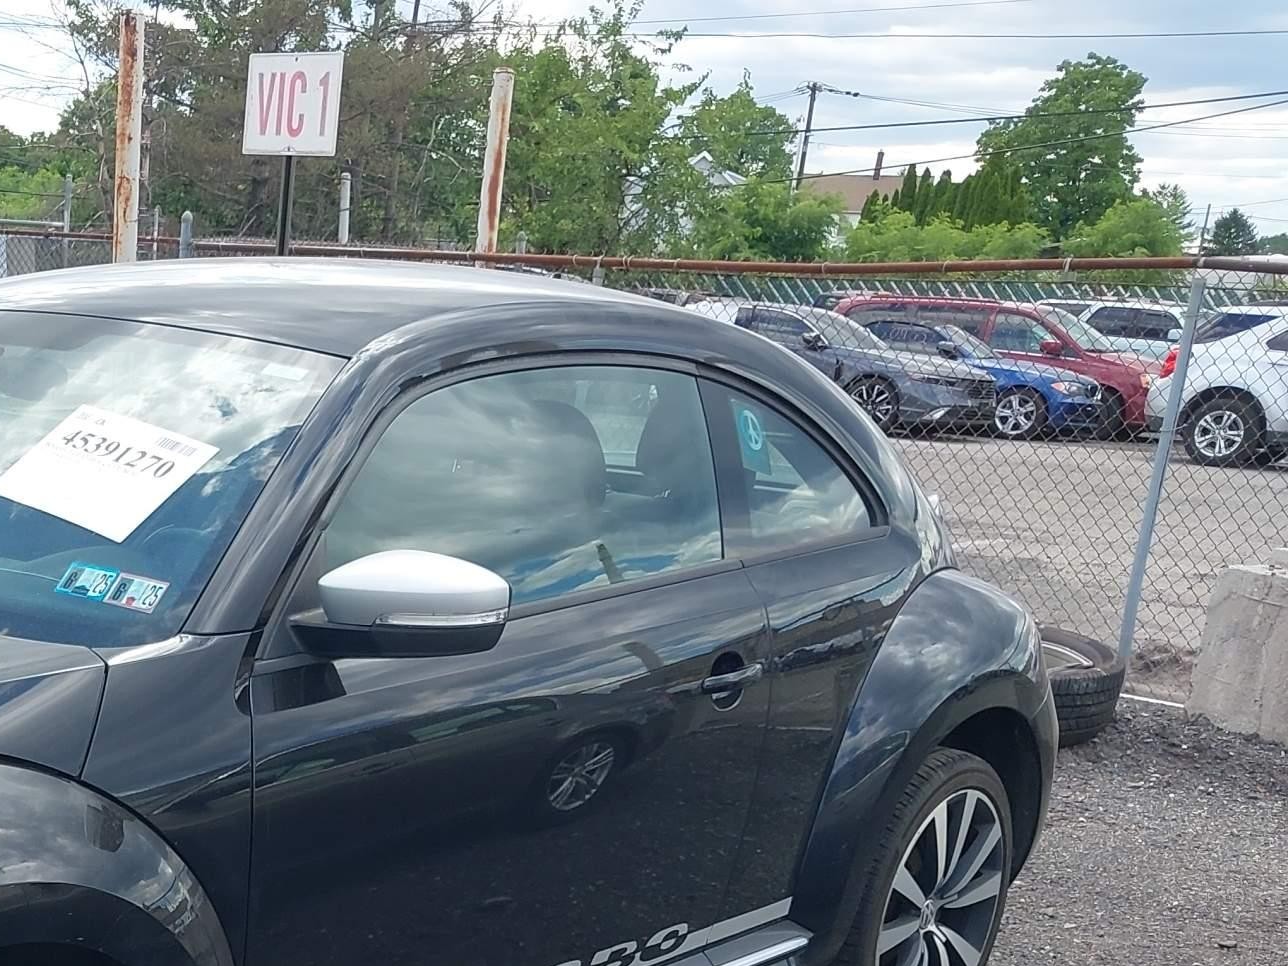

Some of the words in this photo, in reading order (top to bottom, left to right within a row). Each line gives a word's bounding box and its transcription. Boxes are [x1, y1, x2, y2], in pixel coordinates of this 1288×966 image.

[258, 71, 307, 138] VIC
[319, 71, 330, 137] 1
[62, 430, 175, 479] 45391270
[92, 573, 114, 595] 25
[141, 585, 164, 607] 25
